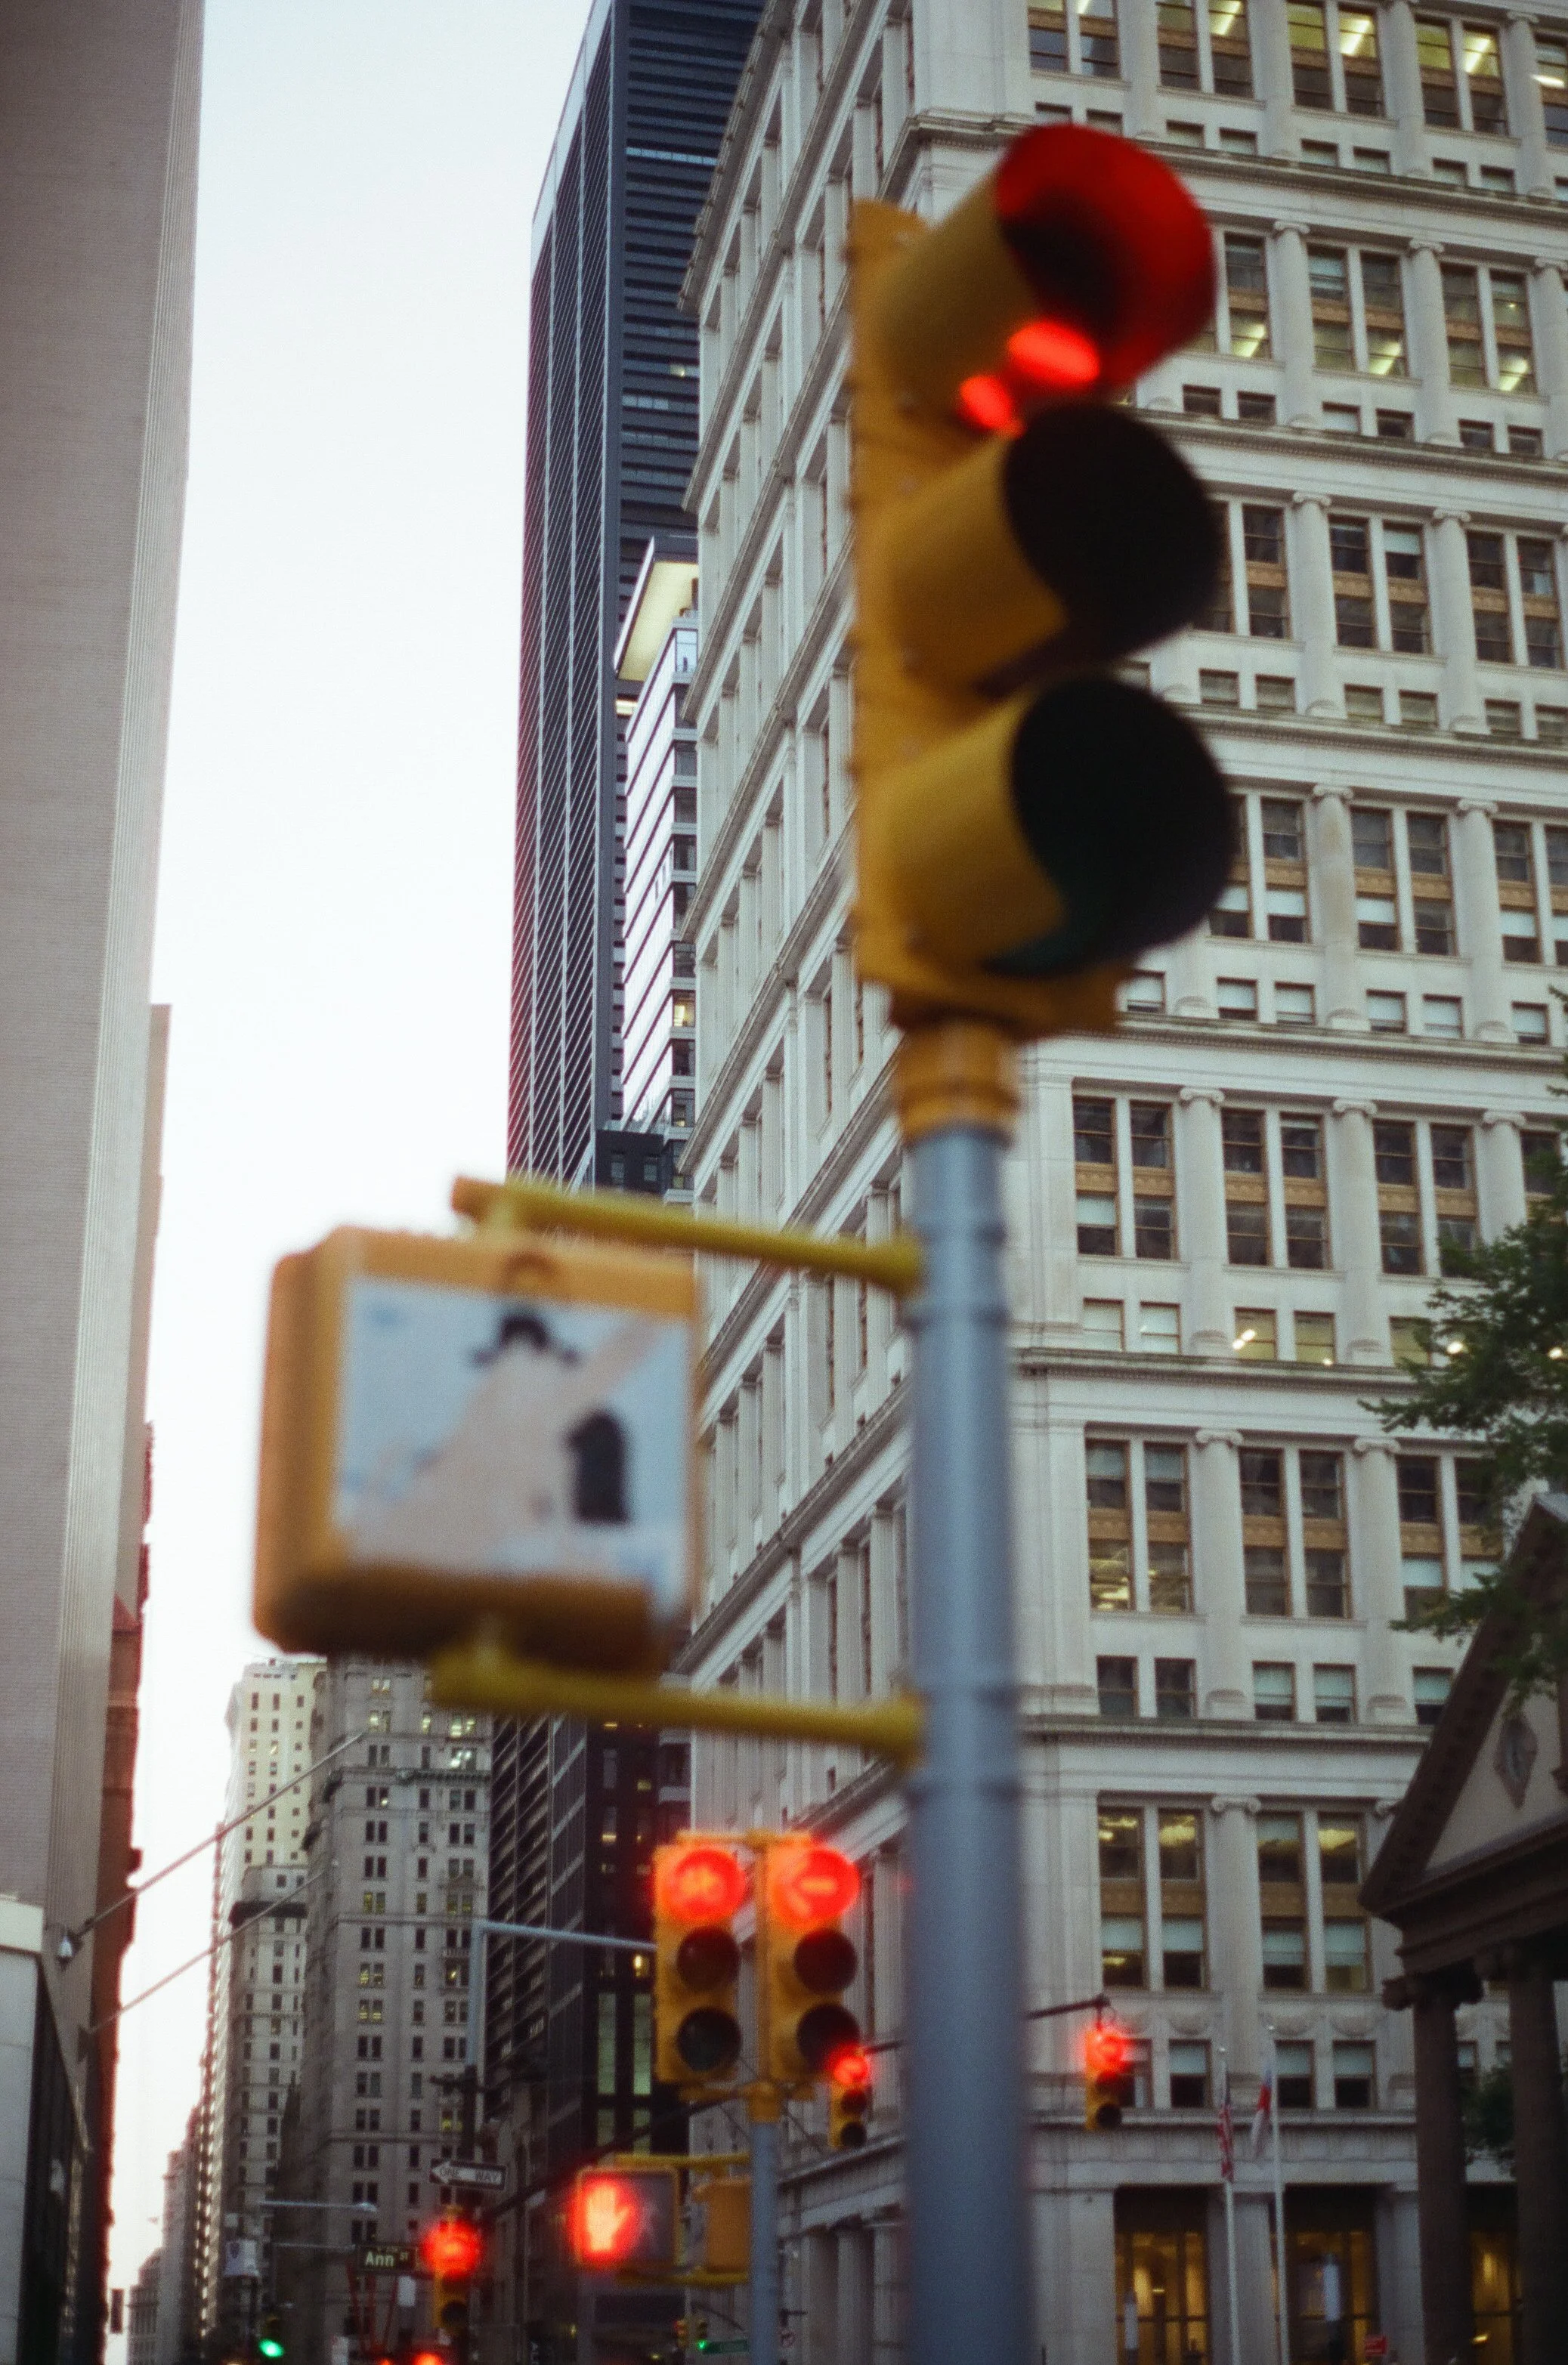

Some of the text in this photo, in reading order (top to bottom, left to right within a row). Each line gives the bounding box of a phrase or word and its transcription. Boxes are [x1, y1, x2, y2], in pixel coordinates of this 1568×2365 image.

[440, 2168, 499, 2183] ONE WAY
[365, 2251, 394, 2267] Ann
